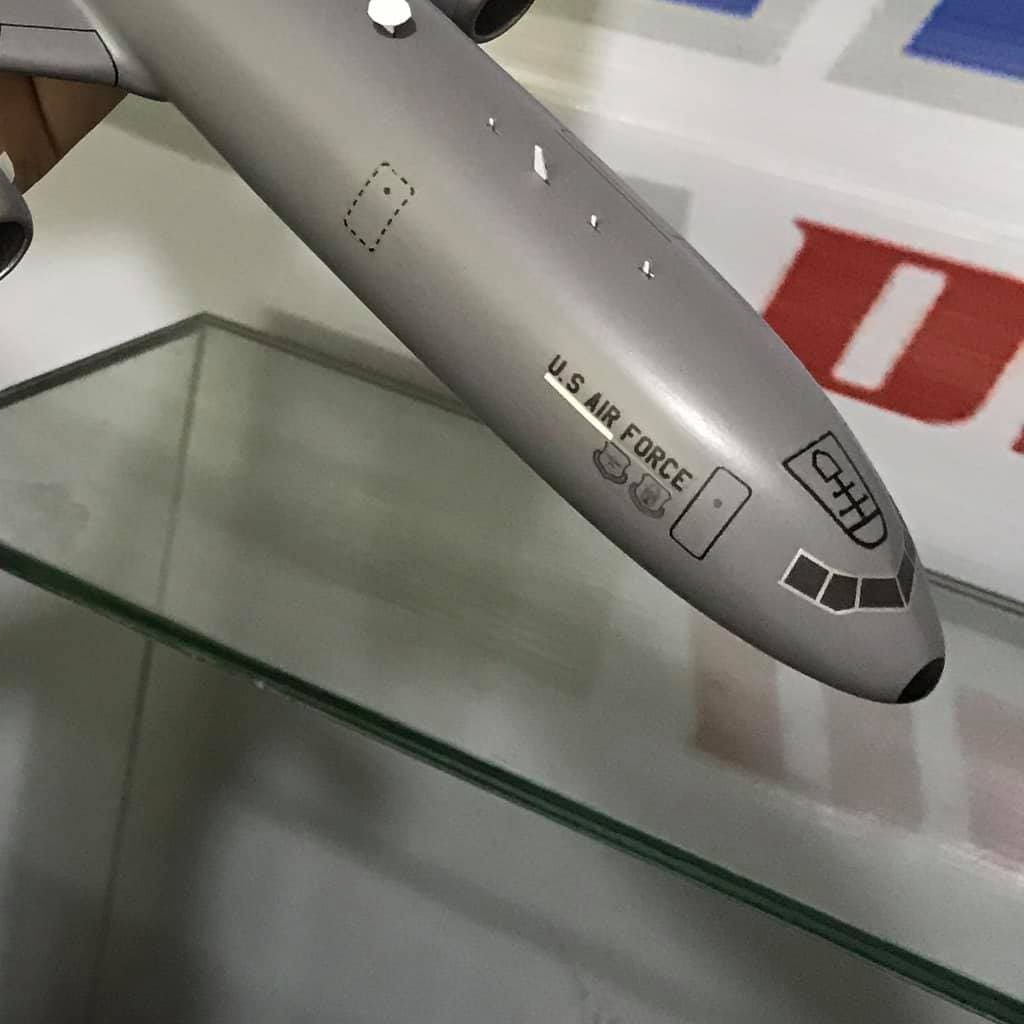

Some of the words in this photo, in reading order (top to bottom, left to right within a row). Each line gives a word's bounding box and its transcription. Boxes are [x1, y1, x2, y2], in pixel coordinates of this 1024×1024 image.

[547, 354, 585, 394] U.S
[584, 392, 621, 428] AIR
[620, 424, 693, 491] FORCE
